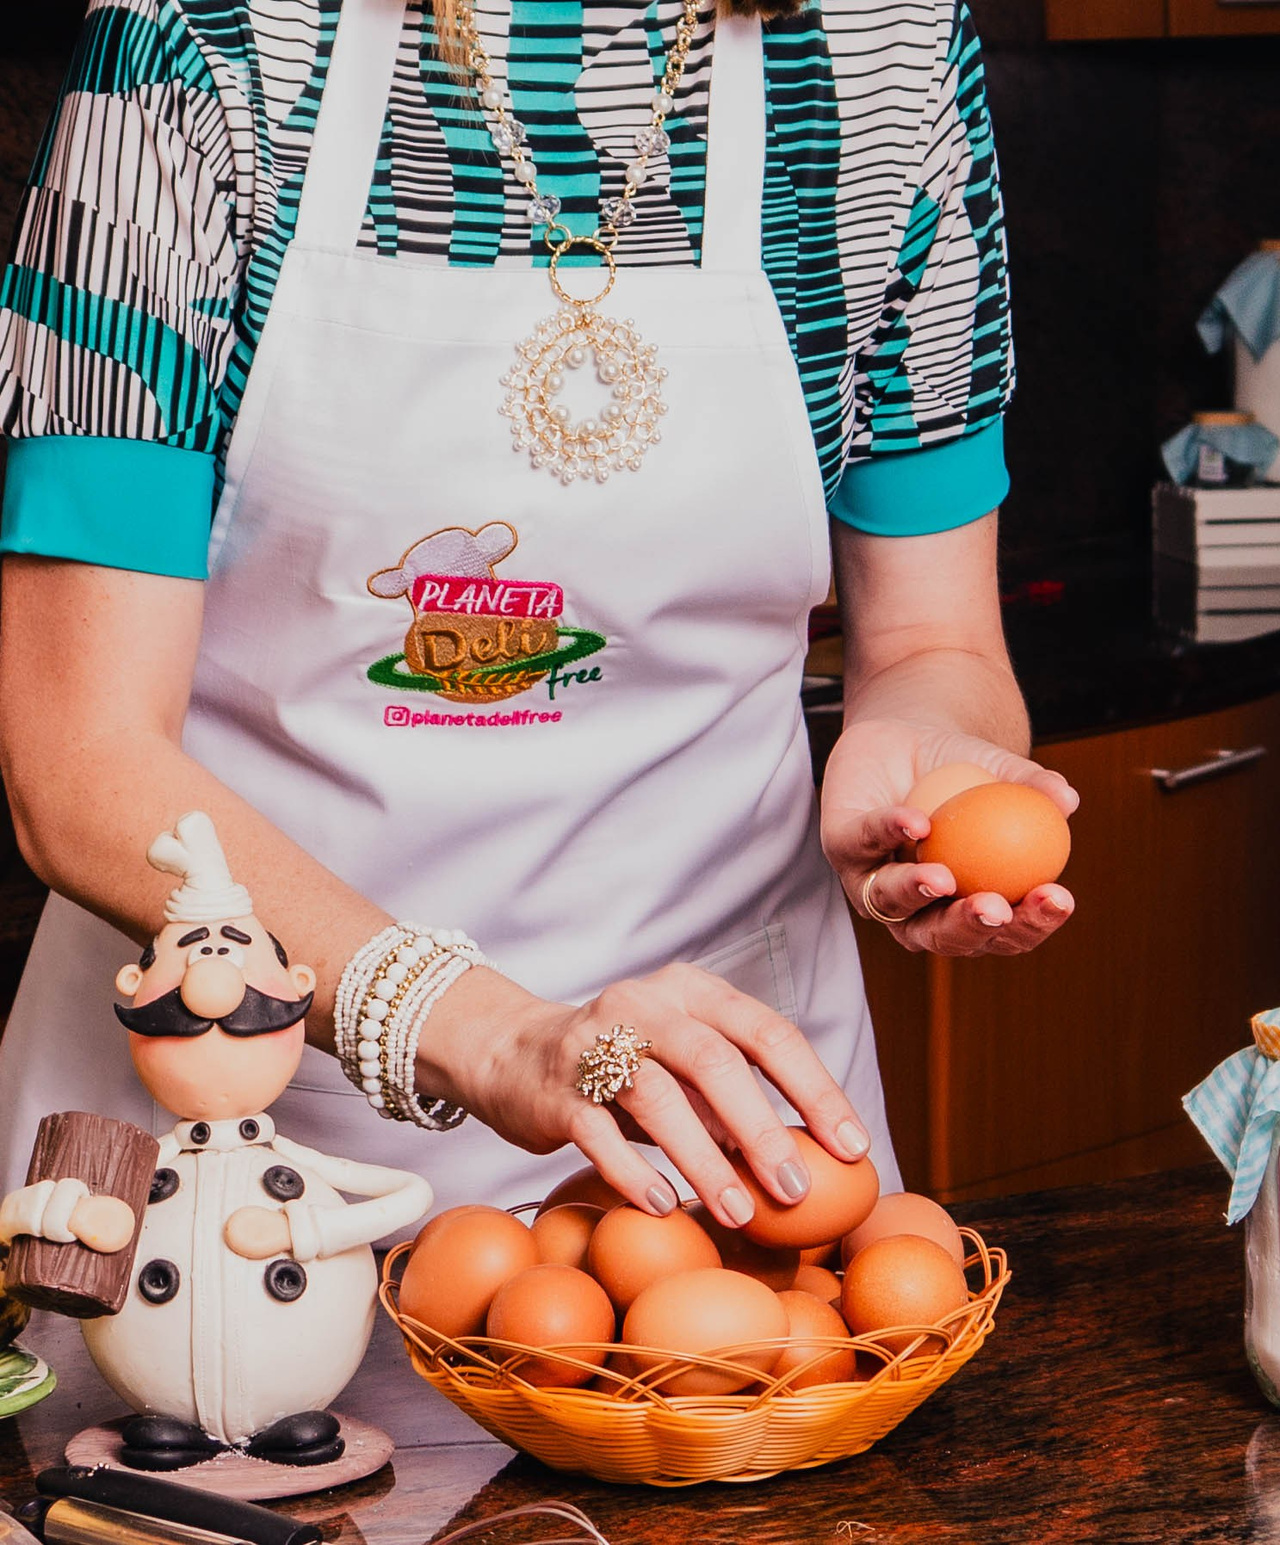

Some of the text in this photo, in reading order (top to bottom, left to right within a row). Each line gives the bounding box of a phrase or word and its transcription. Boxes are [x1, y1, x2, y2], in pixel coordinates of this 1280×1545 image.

[418, 580, 560, 617] PLANETA
[420, 619, 547, 670] Deli
[546, 662, 603, 700] free
